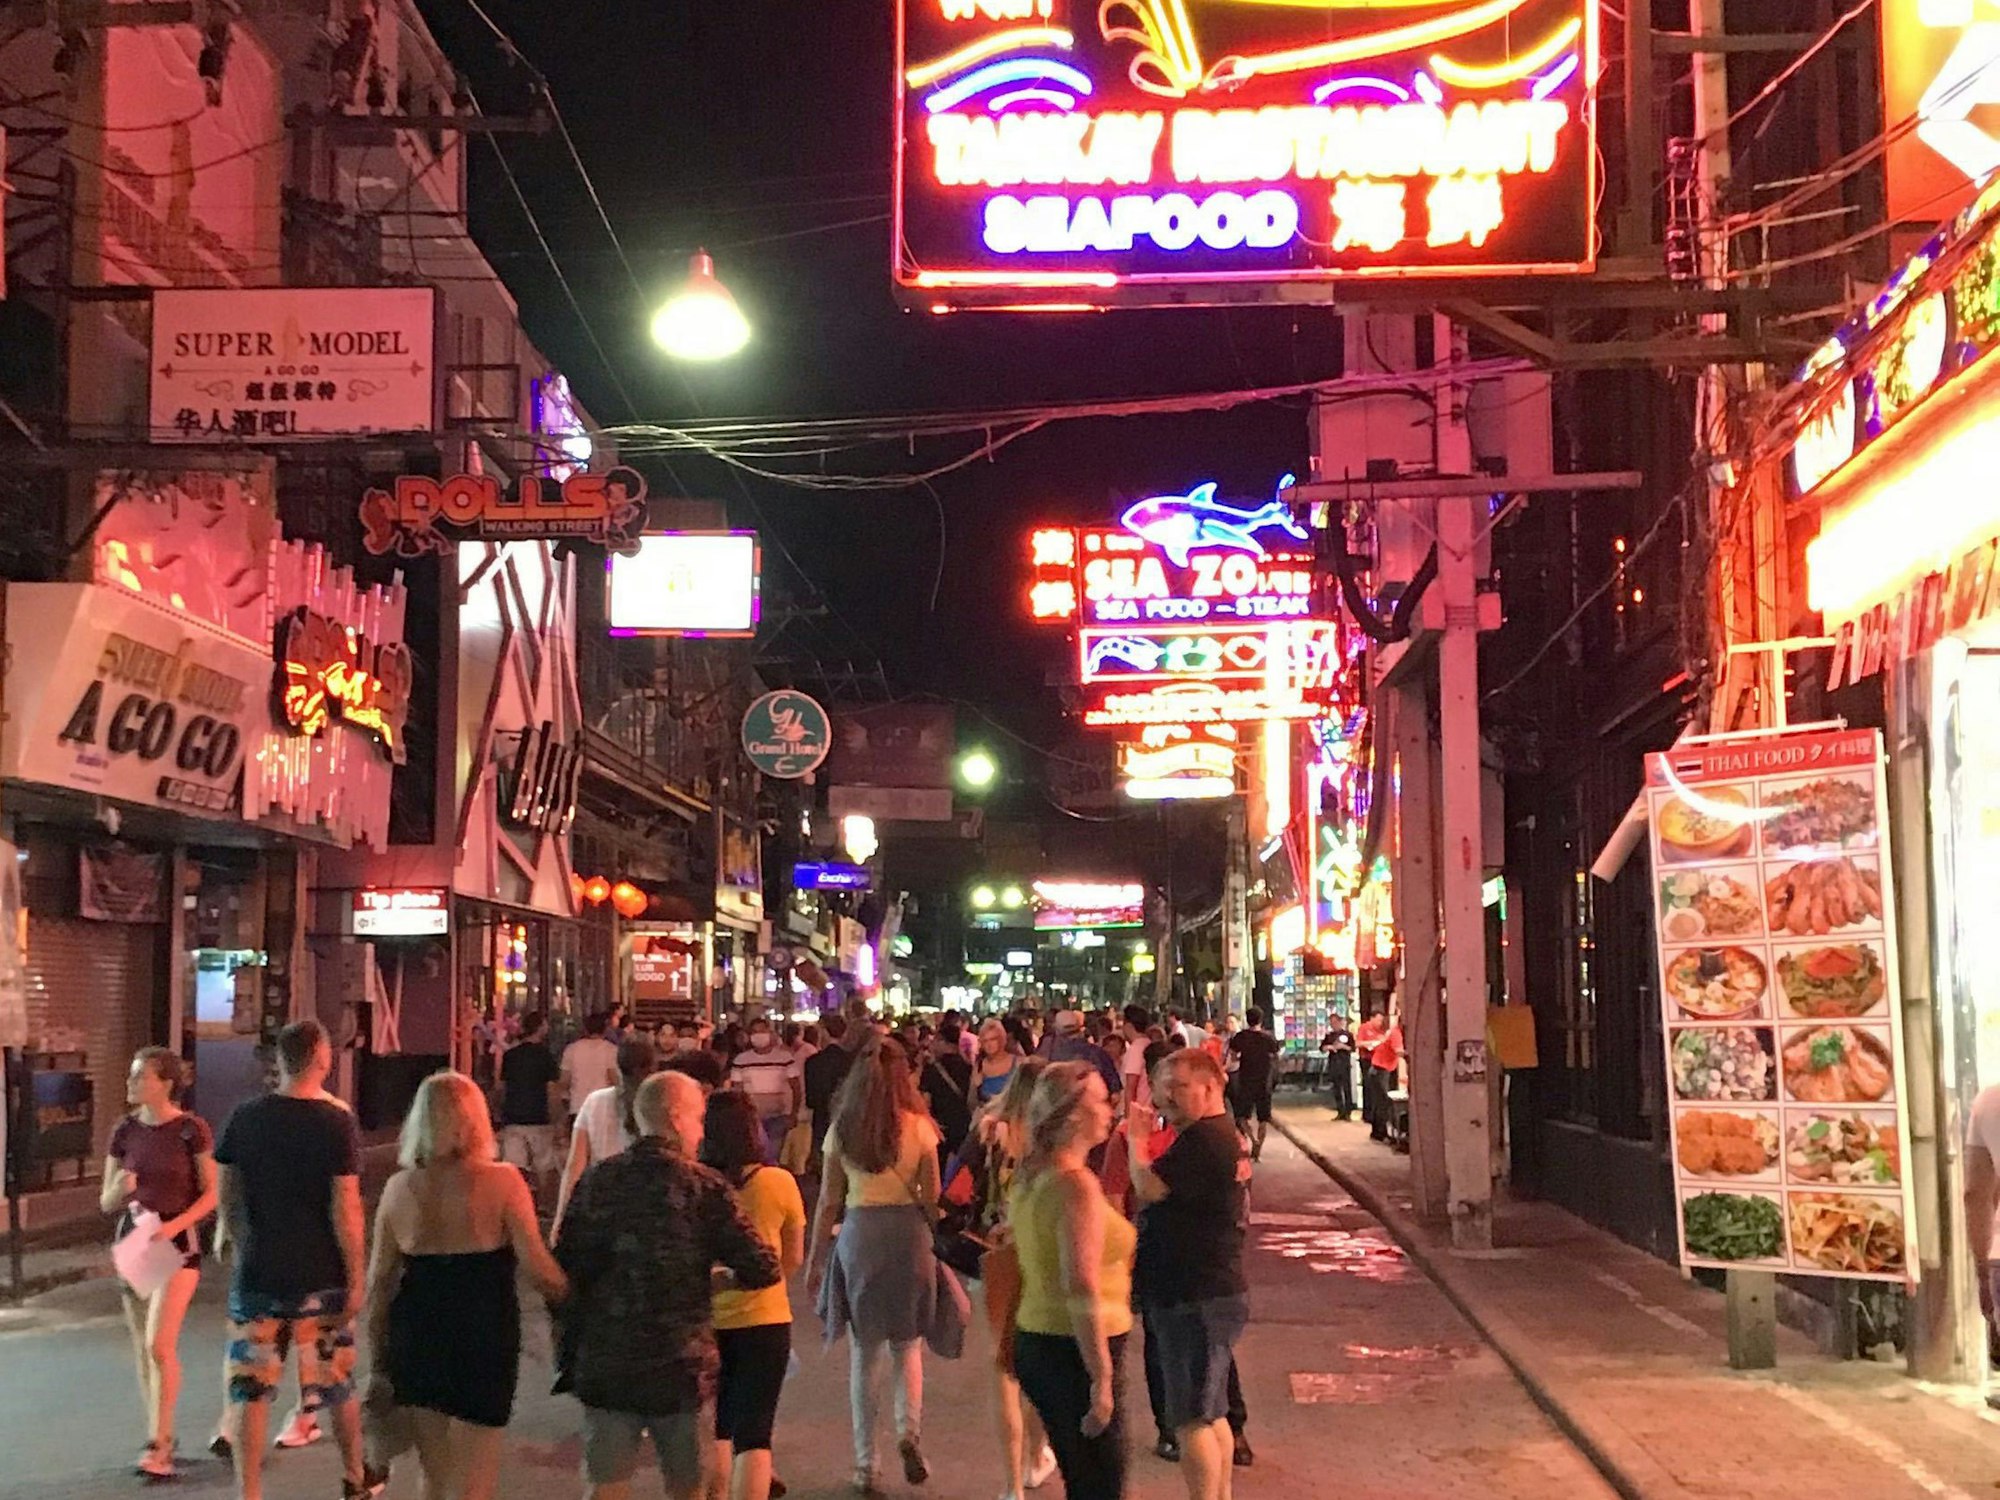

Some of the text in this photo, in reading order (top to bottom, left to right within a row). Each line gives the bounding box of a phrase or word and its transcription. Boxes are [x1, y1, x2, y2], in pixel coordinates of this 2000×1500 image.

[983, 190, 1298, 254] SEAFOOD
[174, 331, 409, 357] SUPER MODEL
[277, 365, 297, 376] GO
[301, 365, 319, 376] GO
[397, 476, 609, 521] DOLLS
[486, 519, 602, 533] WALKING STREET
[1084, 557, 1171, 600] SEA
[1094, 599, 1140, 620] SEA
[1145, 598, 1210, 619] FOOD
[1235, 596, 1310, 617] STEAK
[57, 679, 241, 779] A GO GO
[749, 741, 823, 756] Grand Hotel
[1706, 751, 1750, 773] THAI
[1754, 746, 1806, 769] FOOD
